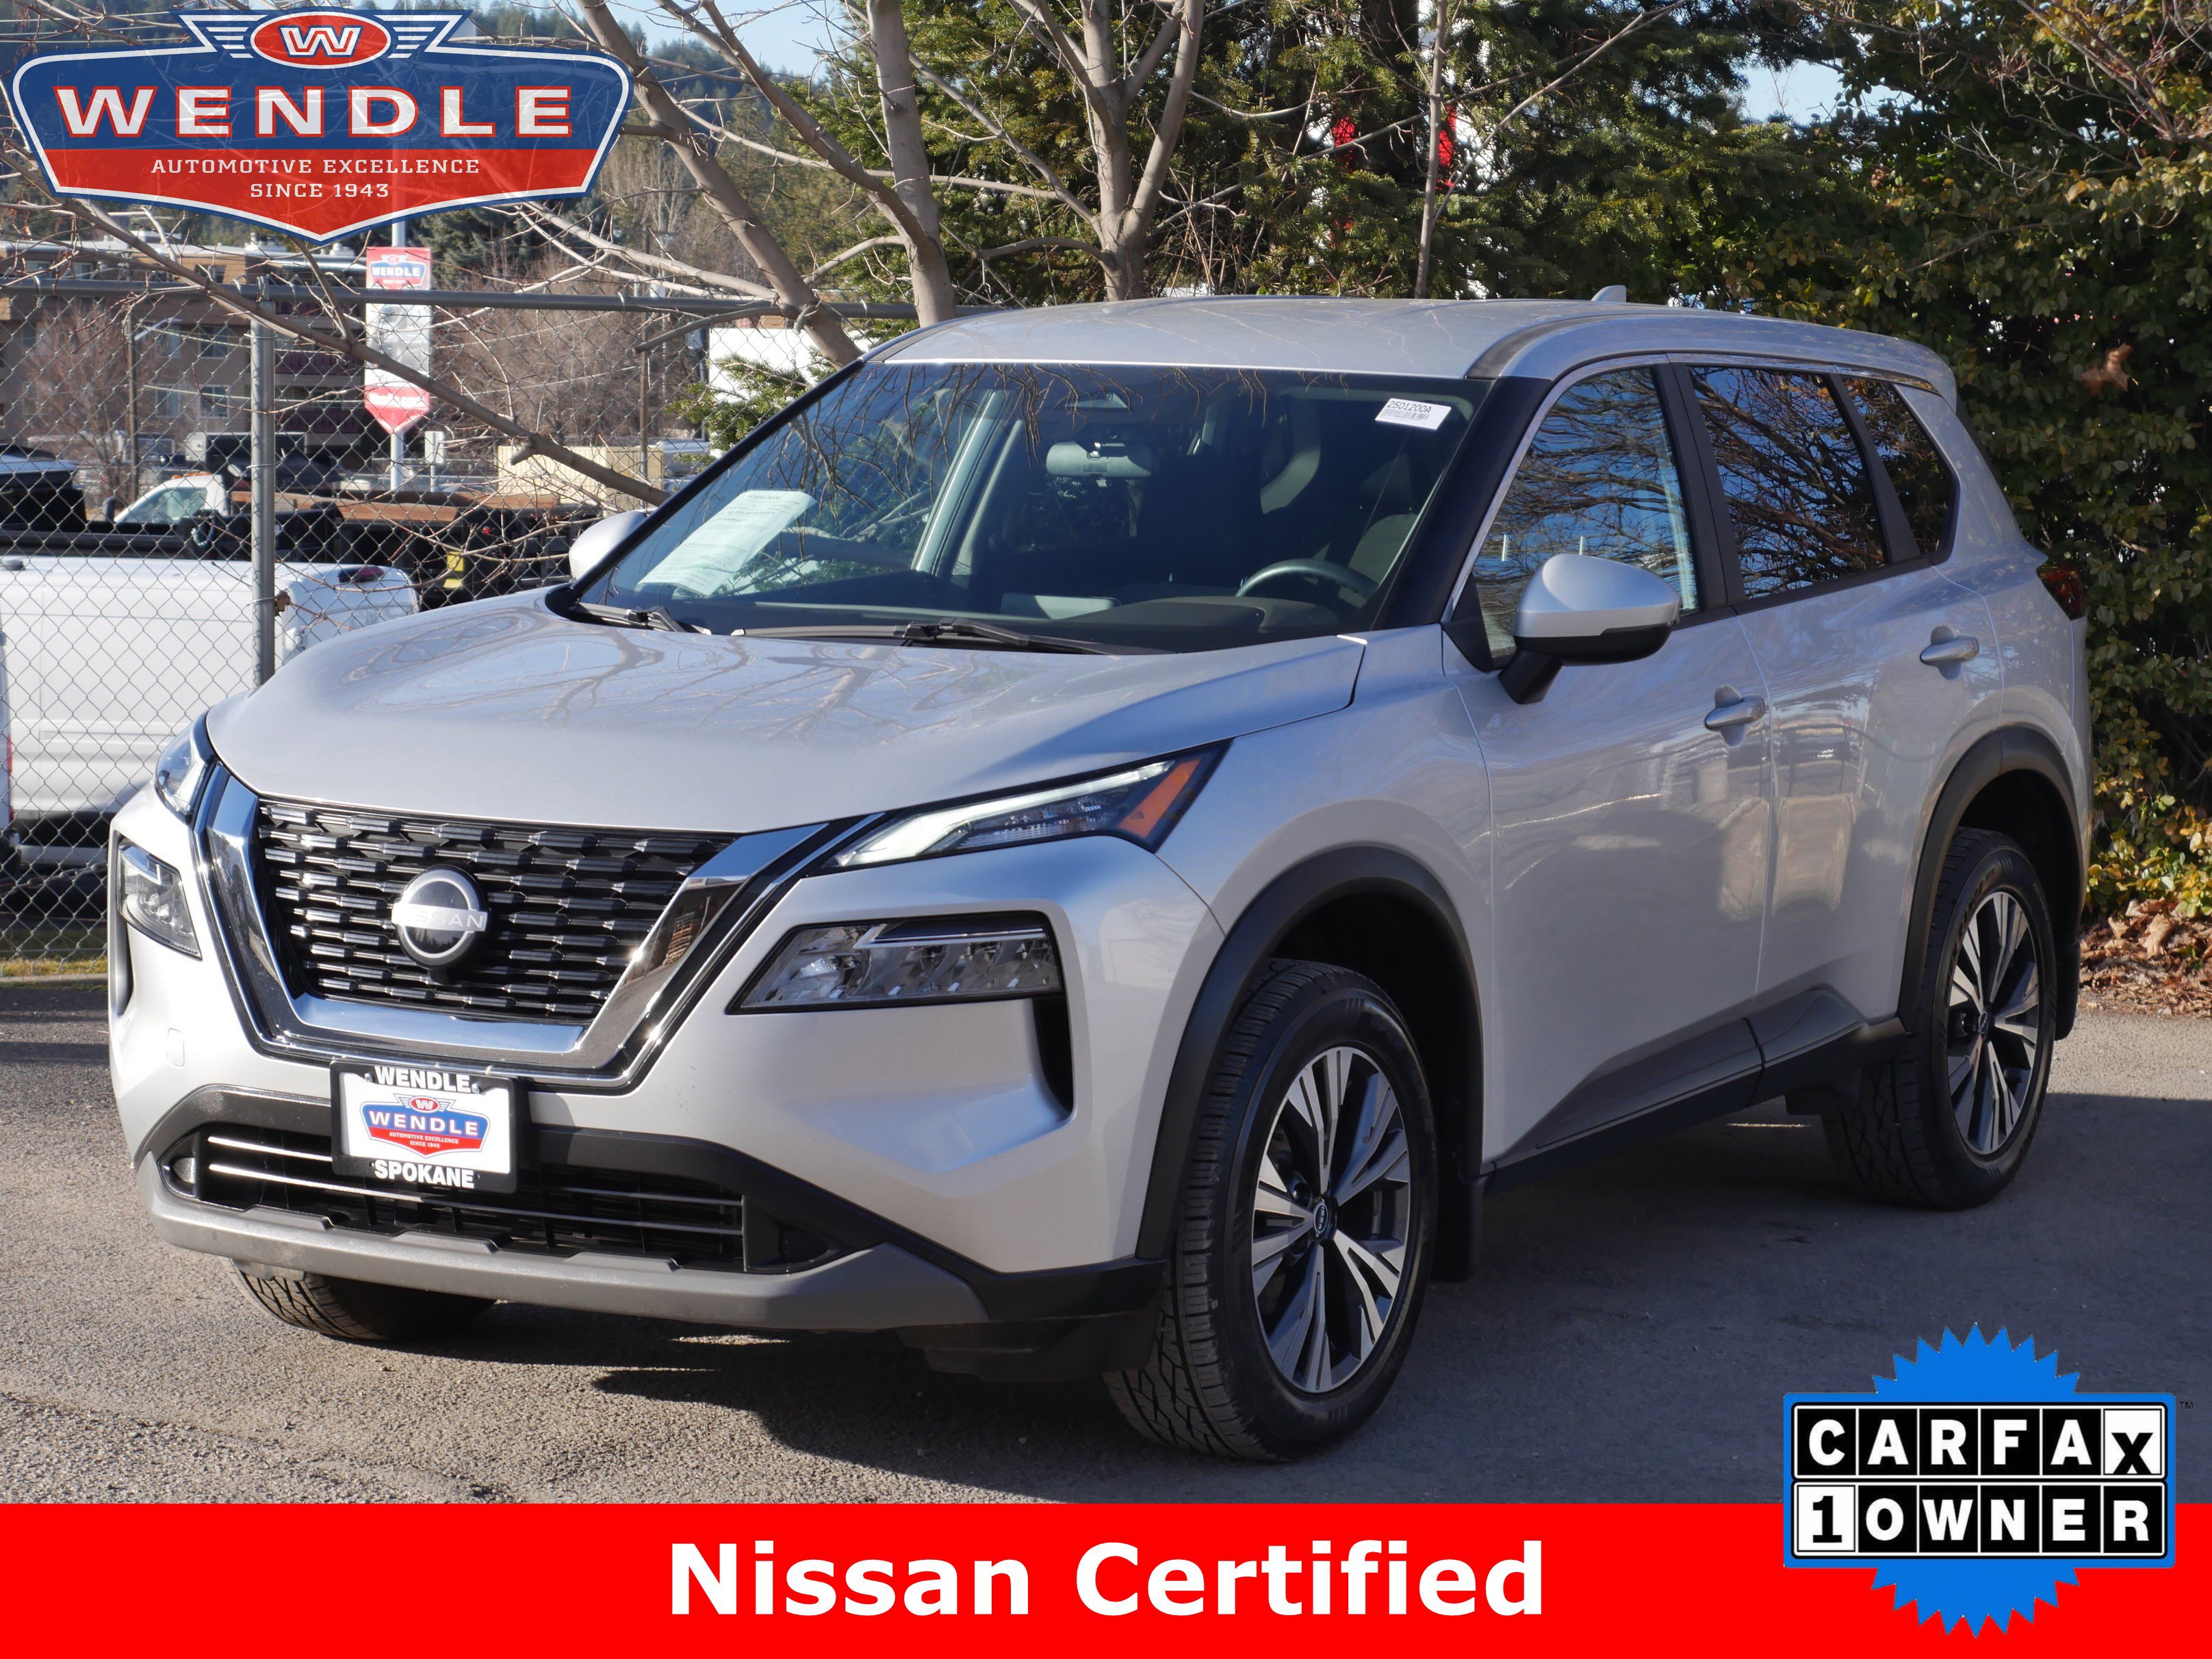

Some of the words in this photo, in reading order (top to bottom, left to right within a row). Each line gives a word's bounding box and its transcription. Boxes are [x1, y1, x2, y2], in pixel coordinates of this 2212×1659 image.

[372, 266, 421, 277] WENDLE
[1387, 400, 1432, 413] 2501200A
[374, 1066, 472, 1093] WENDLE
[369, 1111, 478, 1136] WENDLE
[389, 1131, 424, 1140] AUTOMOTIVE
[424, 1135, 459, 1144] EXCELLENCE
[374, 1159, 474, 1189] SPOKANE
